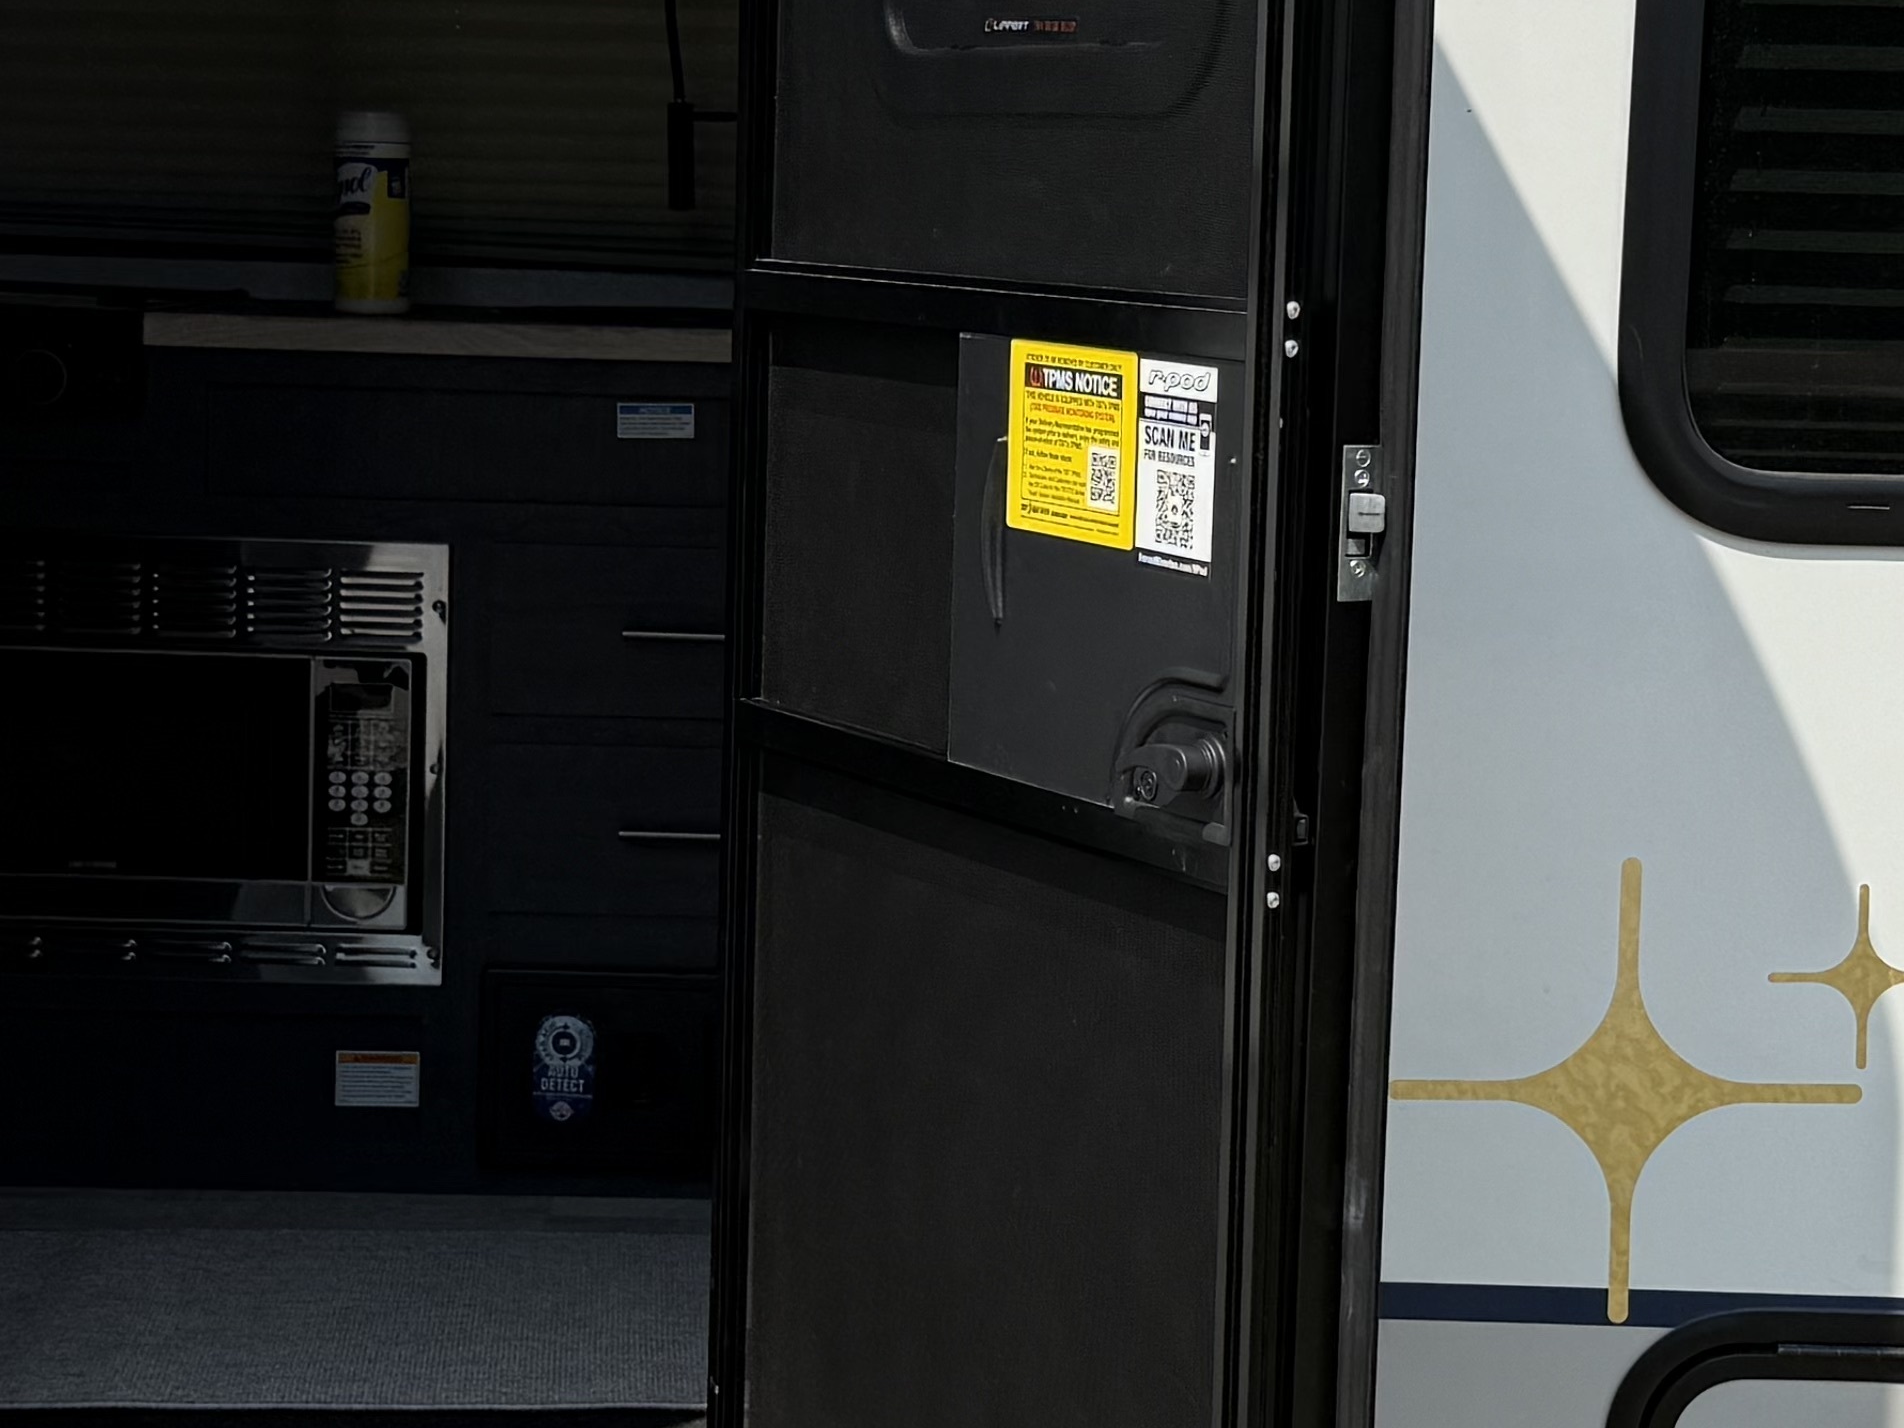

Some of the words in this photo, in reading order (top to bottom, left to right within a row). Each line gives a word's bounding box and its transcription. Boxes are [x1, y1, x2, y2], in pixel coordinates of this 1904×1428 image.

[1042, 367, 1074, 391] TPMS
[1075, 372, 1118, 397] NOTICE
[1144, 425, 1175, 448] SCAN
[1178, 429, 1197, 452] ME
[1157, 450, 1195, 467] RESOURCES
[547, 1065, 580, 1078] AUTO
[540, 1077, 585, 1093] DETECT
